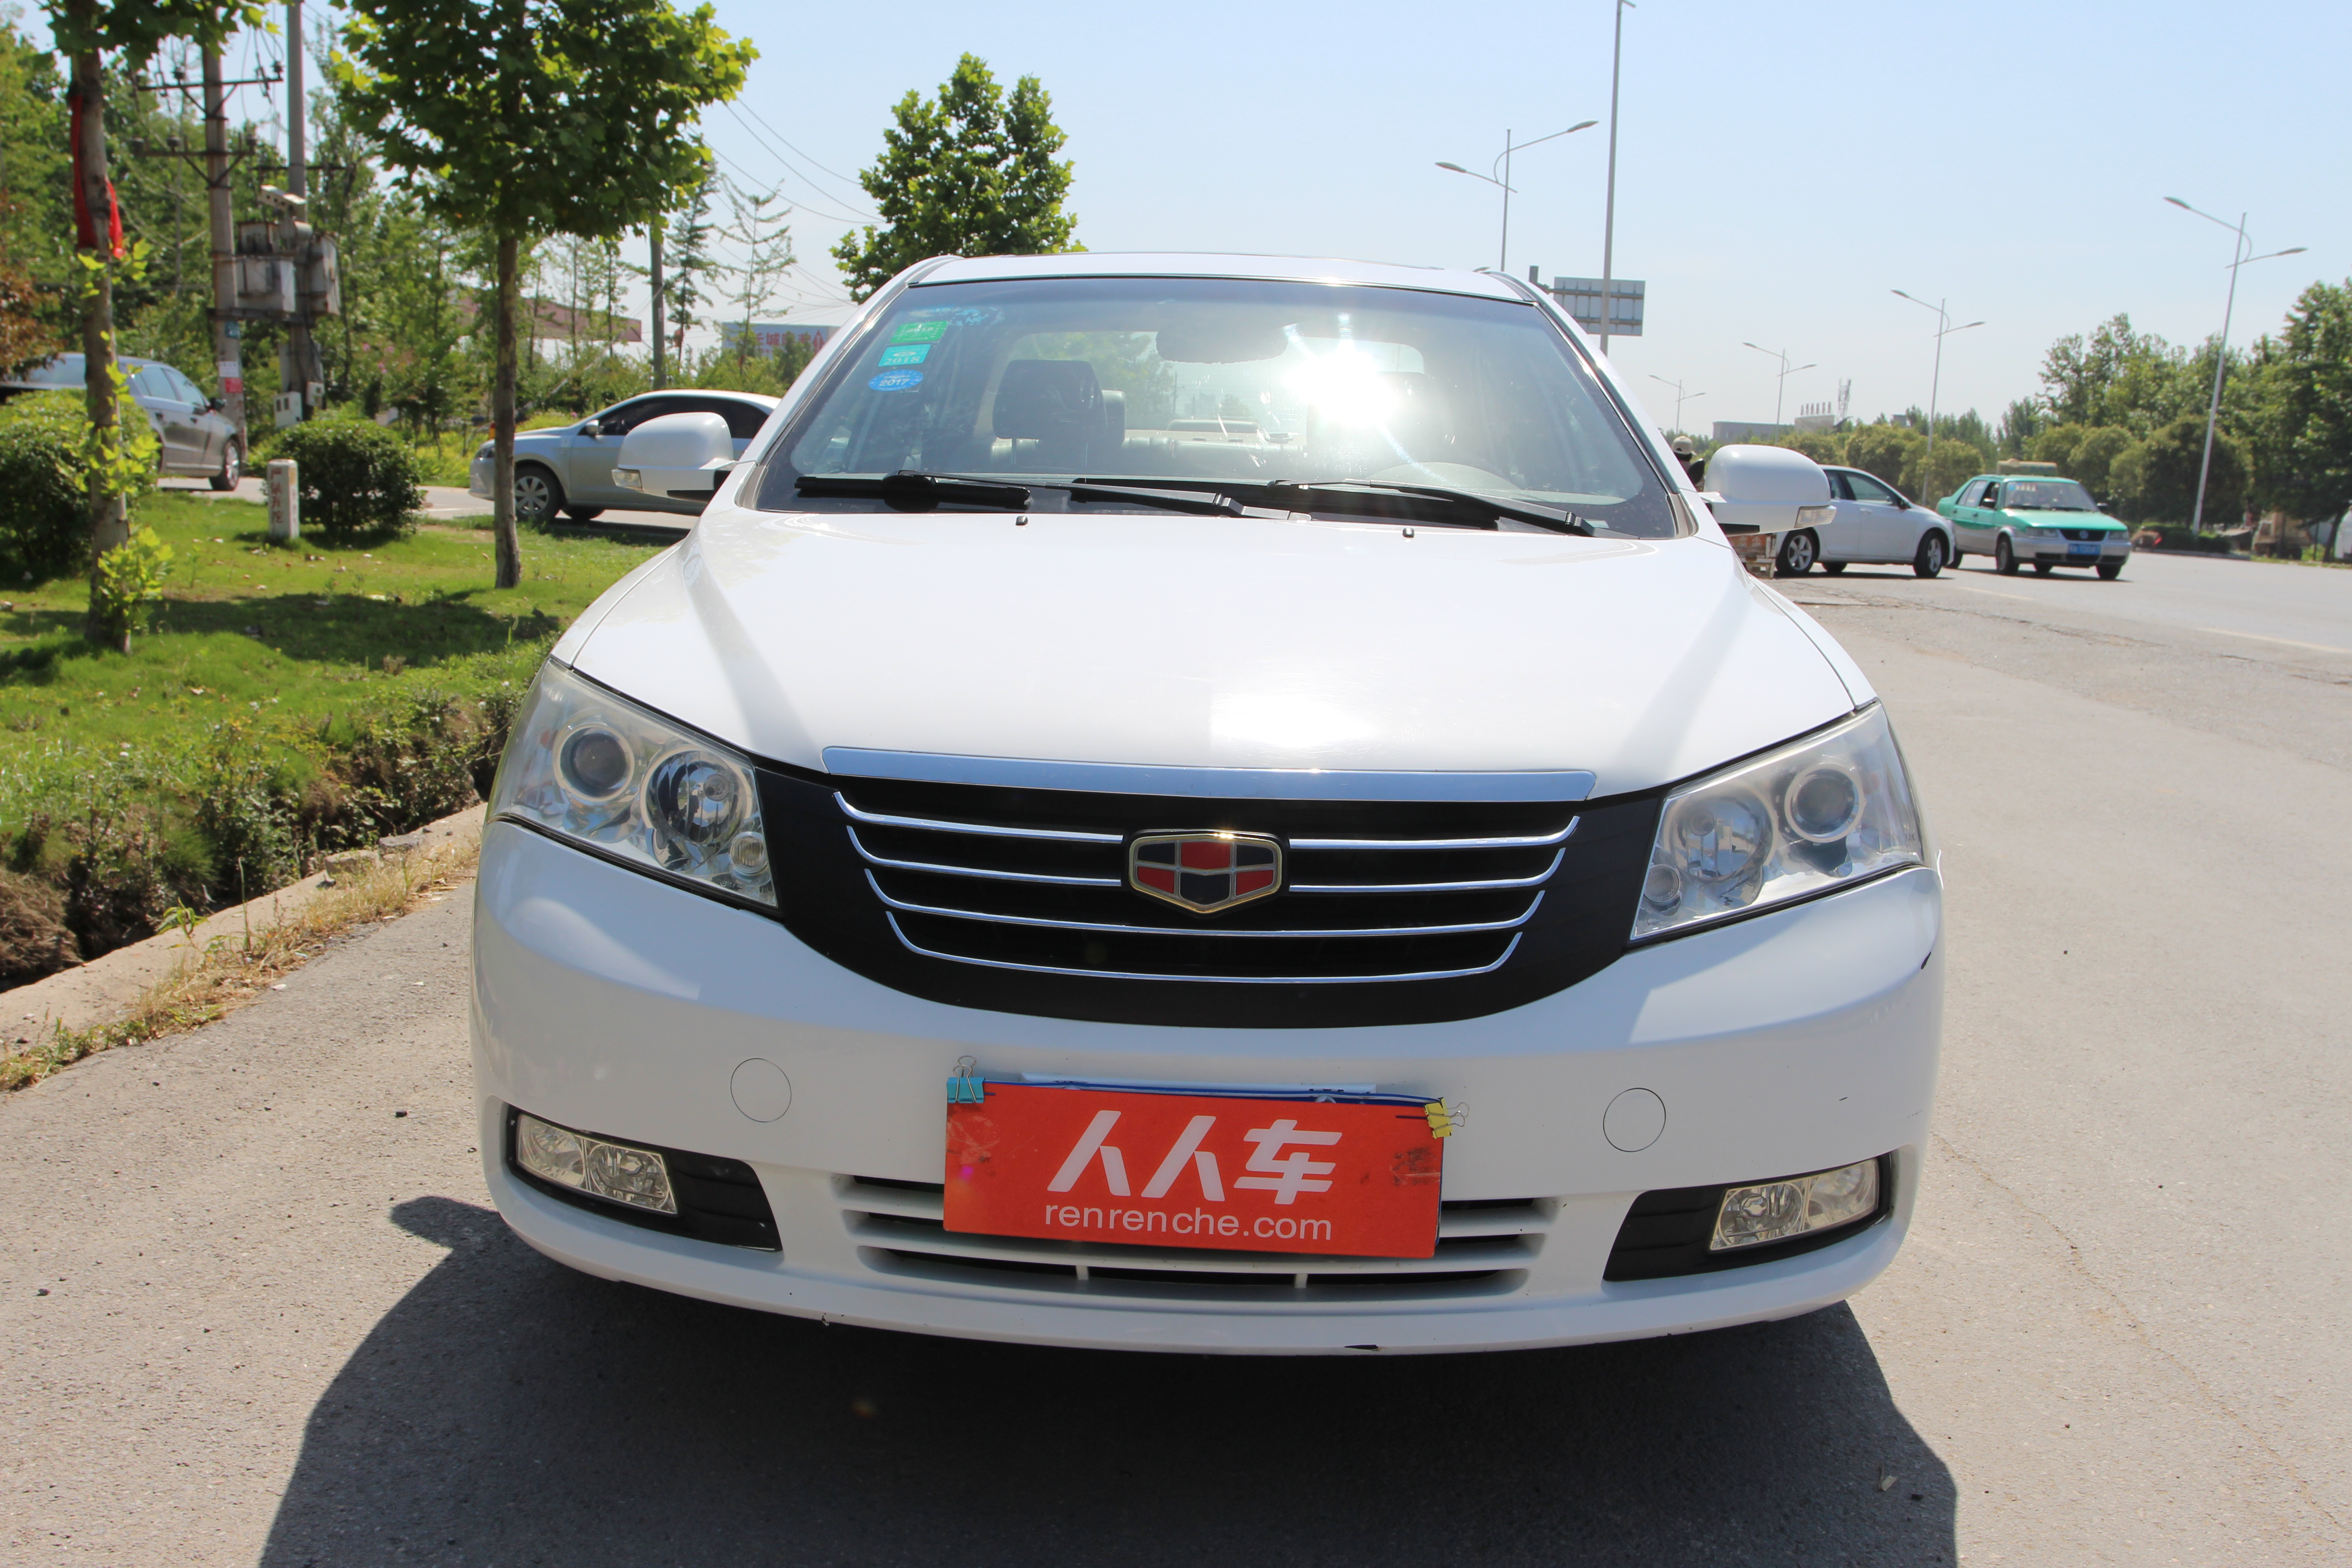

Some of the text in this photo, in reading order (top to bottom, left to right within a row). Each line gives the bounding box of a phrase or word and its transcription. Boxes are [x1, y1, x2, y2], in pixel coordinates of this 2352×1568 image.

[884, 356, 921, 365] 2018
[879, 378, 910, 387] 2017
[1047, 1110, 1343, 1205] 人人车
[1046, 1205, 1331, 1240] renrenche.com
